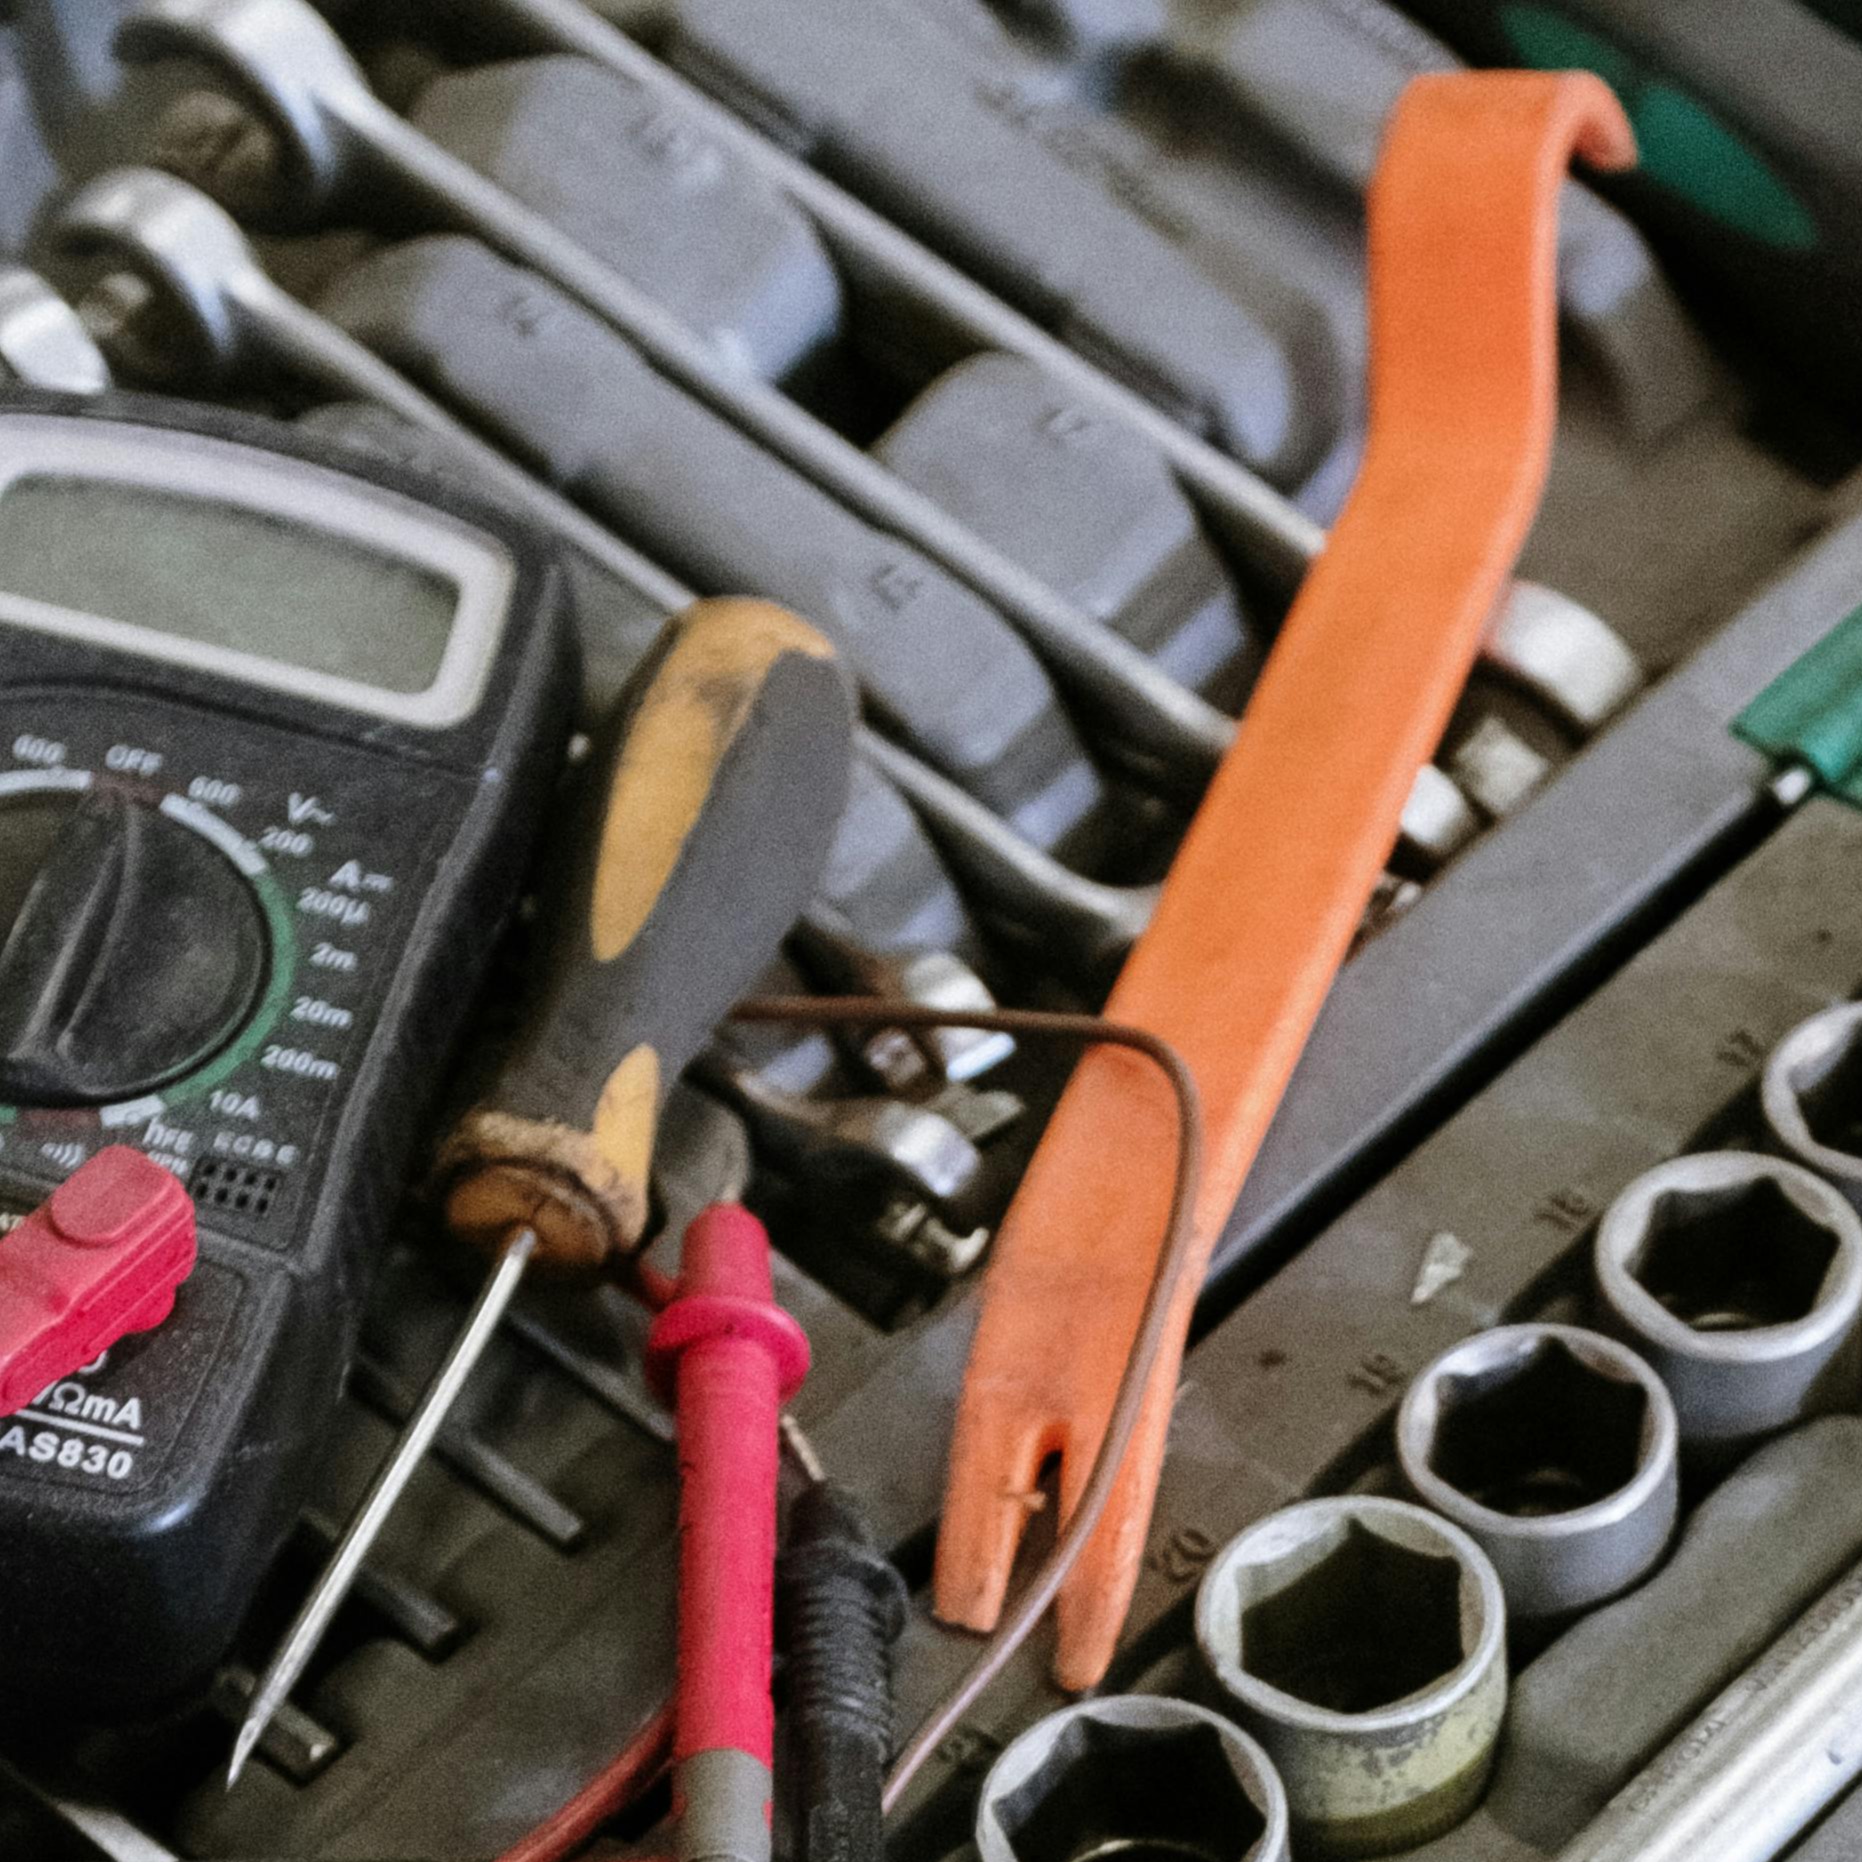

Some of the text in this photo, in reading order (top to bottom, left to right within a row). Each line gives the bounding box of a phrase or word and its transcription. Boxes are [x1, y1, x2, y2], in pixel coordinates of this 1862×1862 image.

[105, 745, 163, 775] OFF
[259, 827, 313, 857] 200
[309, 943, 357, 971] 2m
[290, 997, 352, 1029] 20m
[260, 1045, 338, 1081] 200m
[210, 1090, 260, 1120] 10A
